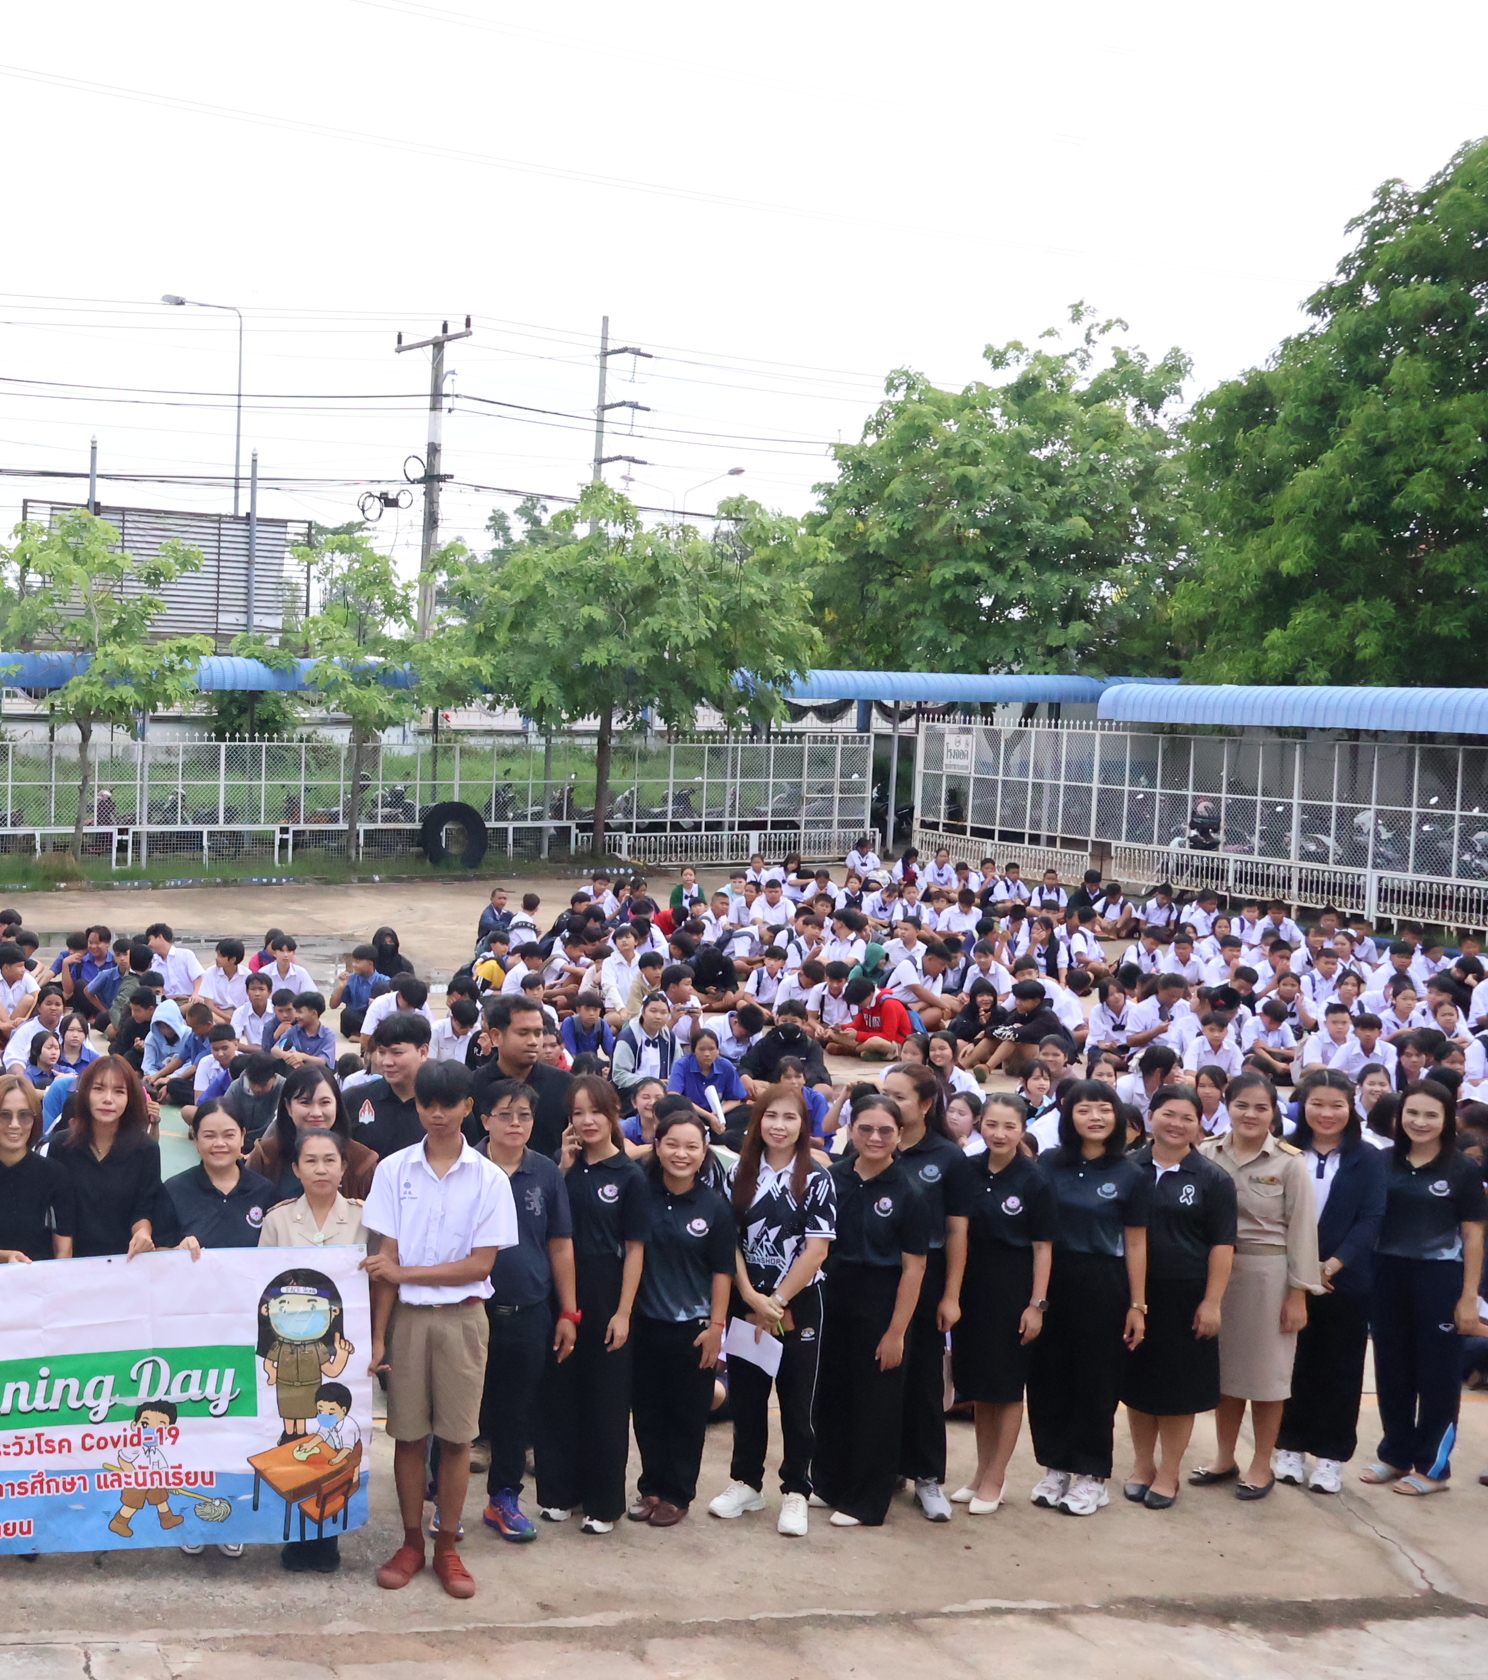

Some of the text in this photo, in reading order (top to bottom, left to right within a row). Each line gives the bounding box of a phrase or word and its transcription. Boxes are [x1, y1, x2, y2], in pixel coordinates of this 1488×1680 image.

[130, 1356, 242, 1417] Day
[81, 1426, 181, 1452] Covid-19
[96, 1463, 216, 1491] และนักเรียน
